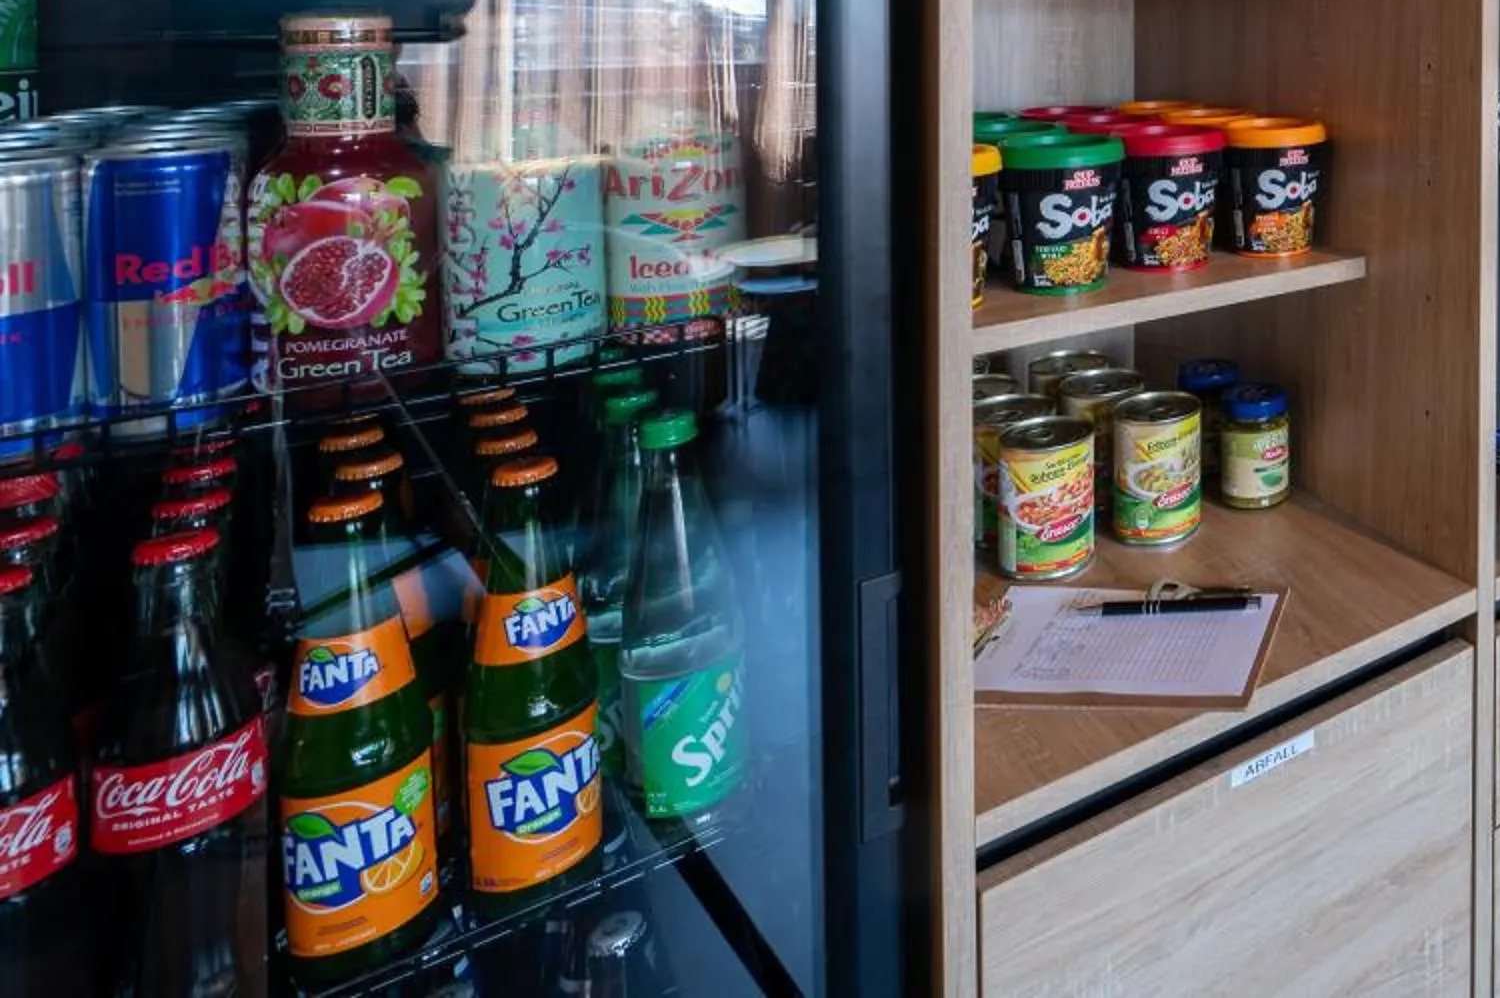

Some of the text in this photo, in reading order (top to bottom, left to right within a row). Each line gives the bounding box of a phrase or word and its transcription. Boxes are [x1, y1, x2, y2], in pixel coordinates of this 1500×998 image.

[1144, 179, 1215, 221] Soba
[1255, 169, 1318, 209] Soba
[1035, 193, 1113, 239] Soba
[115, 245, 203, 285] Red
[496, 300, 573, 323] Green
[285, 328, 409, 354] POMEGRANATE
[277, 347, 413, 380] Green Tea
[504, 594, 577, 647] FANTA
[299, 649, 380, 693] FANTA
[672, 665, 744, 787] Spri
[96, 729, 252, 819] Coca-Cola
[111, 810, 182, 831] ORIGINAL
[283, 807, 417, 886] FANTA
